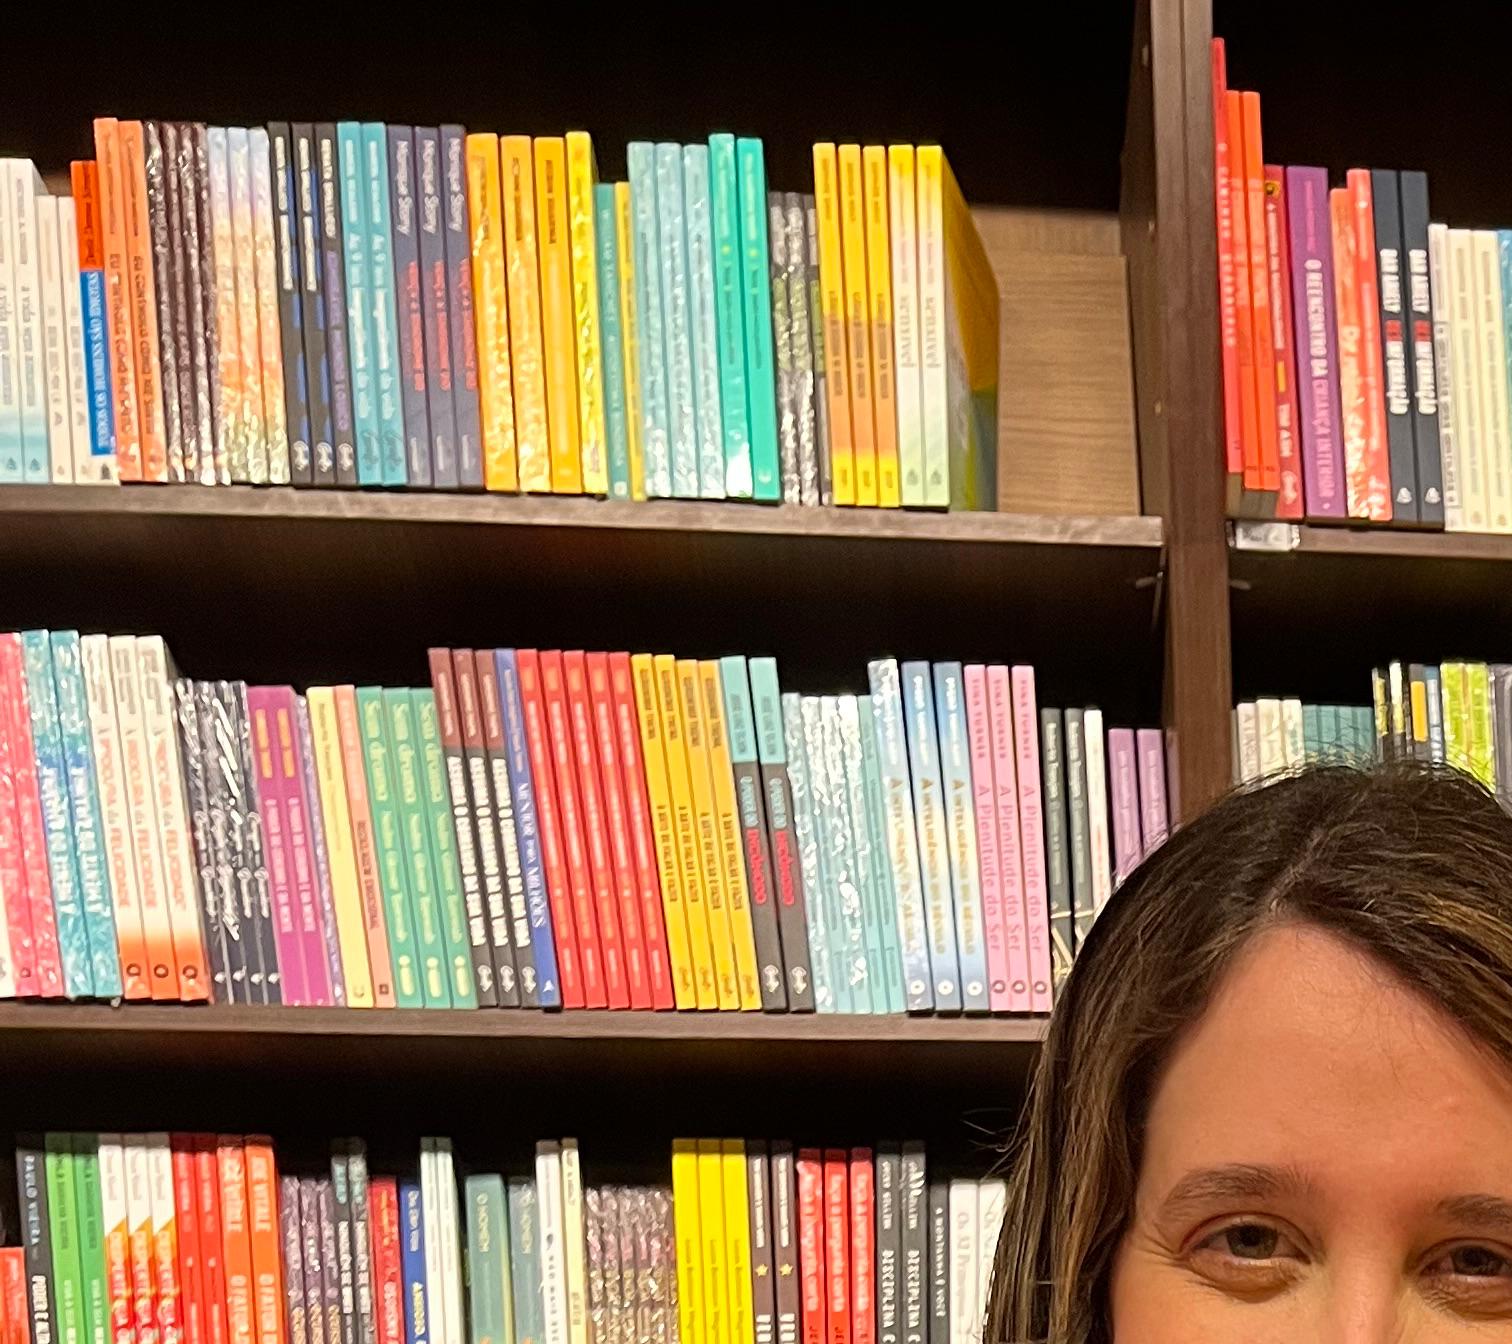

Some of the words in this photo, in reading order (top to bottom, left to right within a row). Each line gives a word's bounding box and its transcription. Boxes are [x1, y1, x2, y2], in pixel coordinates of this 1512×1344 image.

[1304, 259, 1322, 270] O
[1305, 272, 1326, 356] REENCONTRO
[1310, 359, 1327, 377] DA
[978, 804, 996, 889] Plenitude
[987, 924, 1002, 950] Ser
[1000, 804, 1018, 890] Plenitude
[1023, 804, 1040, 891] Plenitude
[1007, 924, 1022, 951] Ser
[1030, 925, 1044, 953] Ser
[881, 1250, 896, 1328] DISCIPLINA
[907, 1250, 921, 1328] DISCIPLINA
